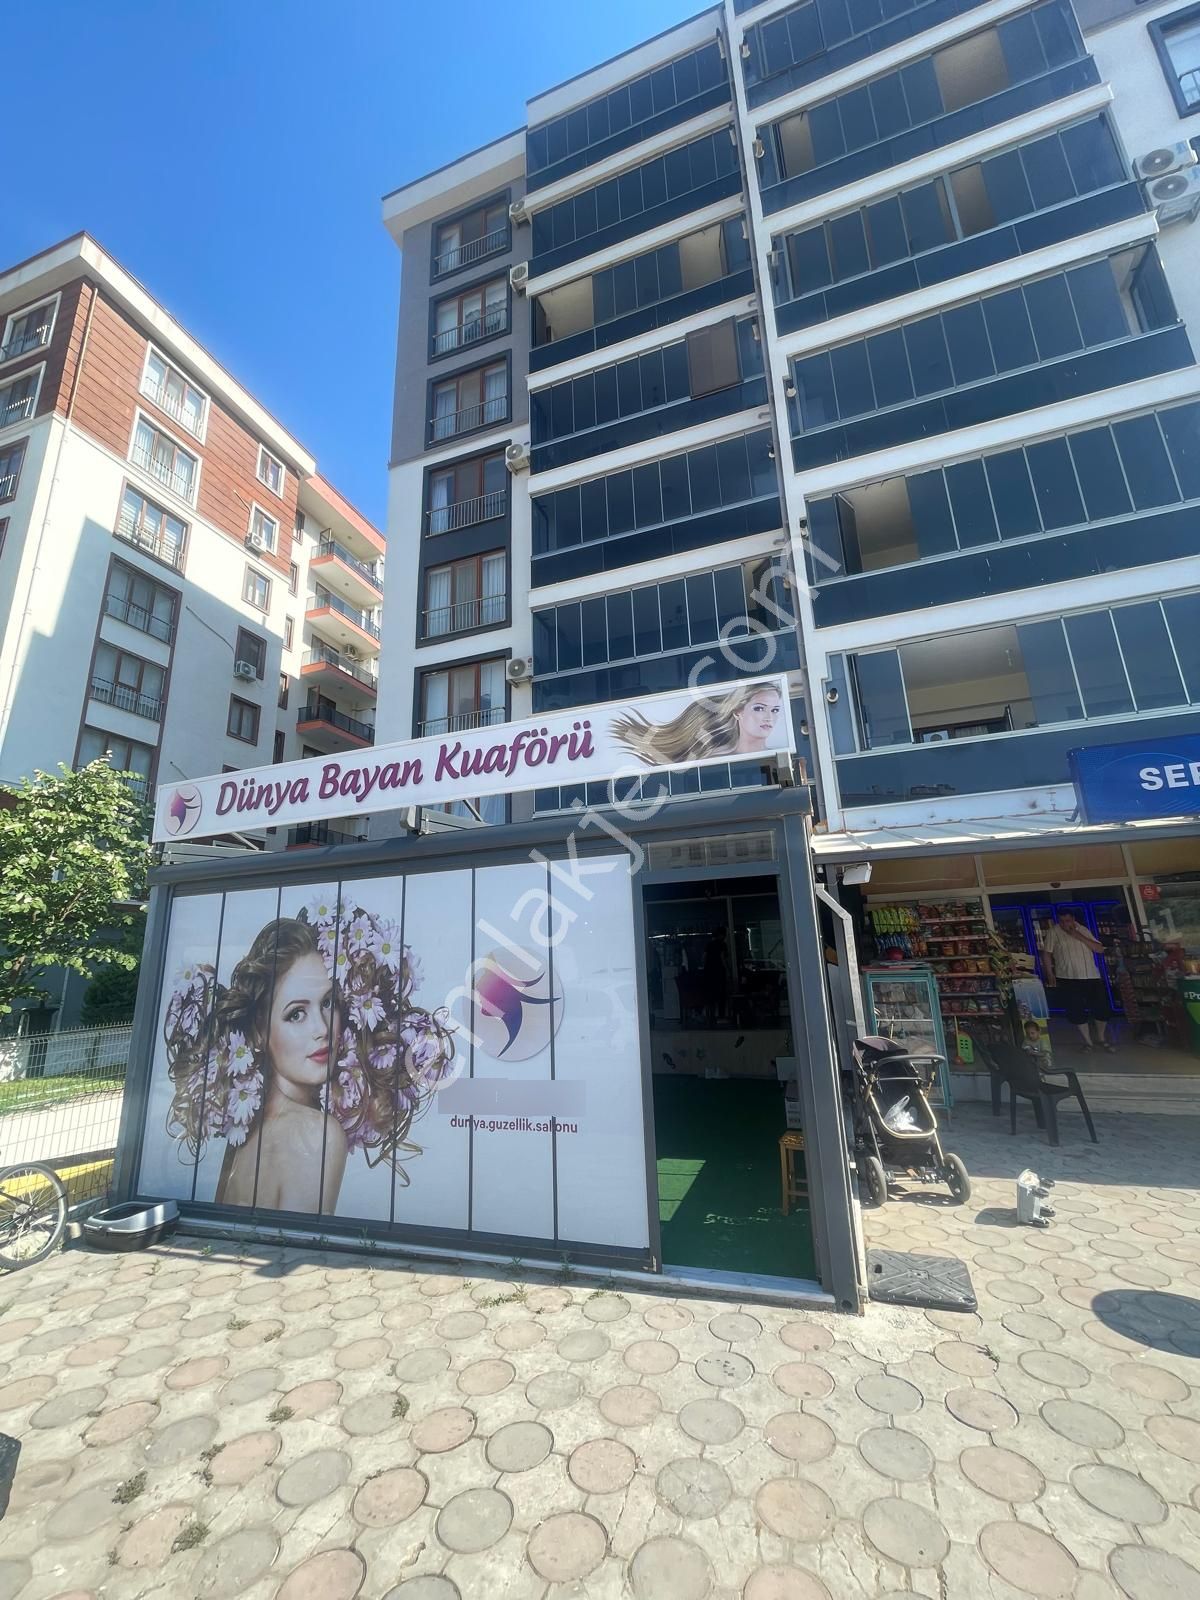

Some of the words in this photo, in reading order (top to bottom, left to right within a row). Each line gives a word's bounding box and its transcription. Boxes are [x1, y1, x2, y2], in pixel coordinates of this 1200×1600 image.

[215, 776, 310, 816] Dünya
[318, 757, 424, 803] Bayan
[434, 719, 595, 782] Kuaförü
[450, 1114, 578, 1134] dunya.guzellik.salonu
